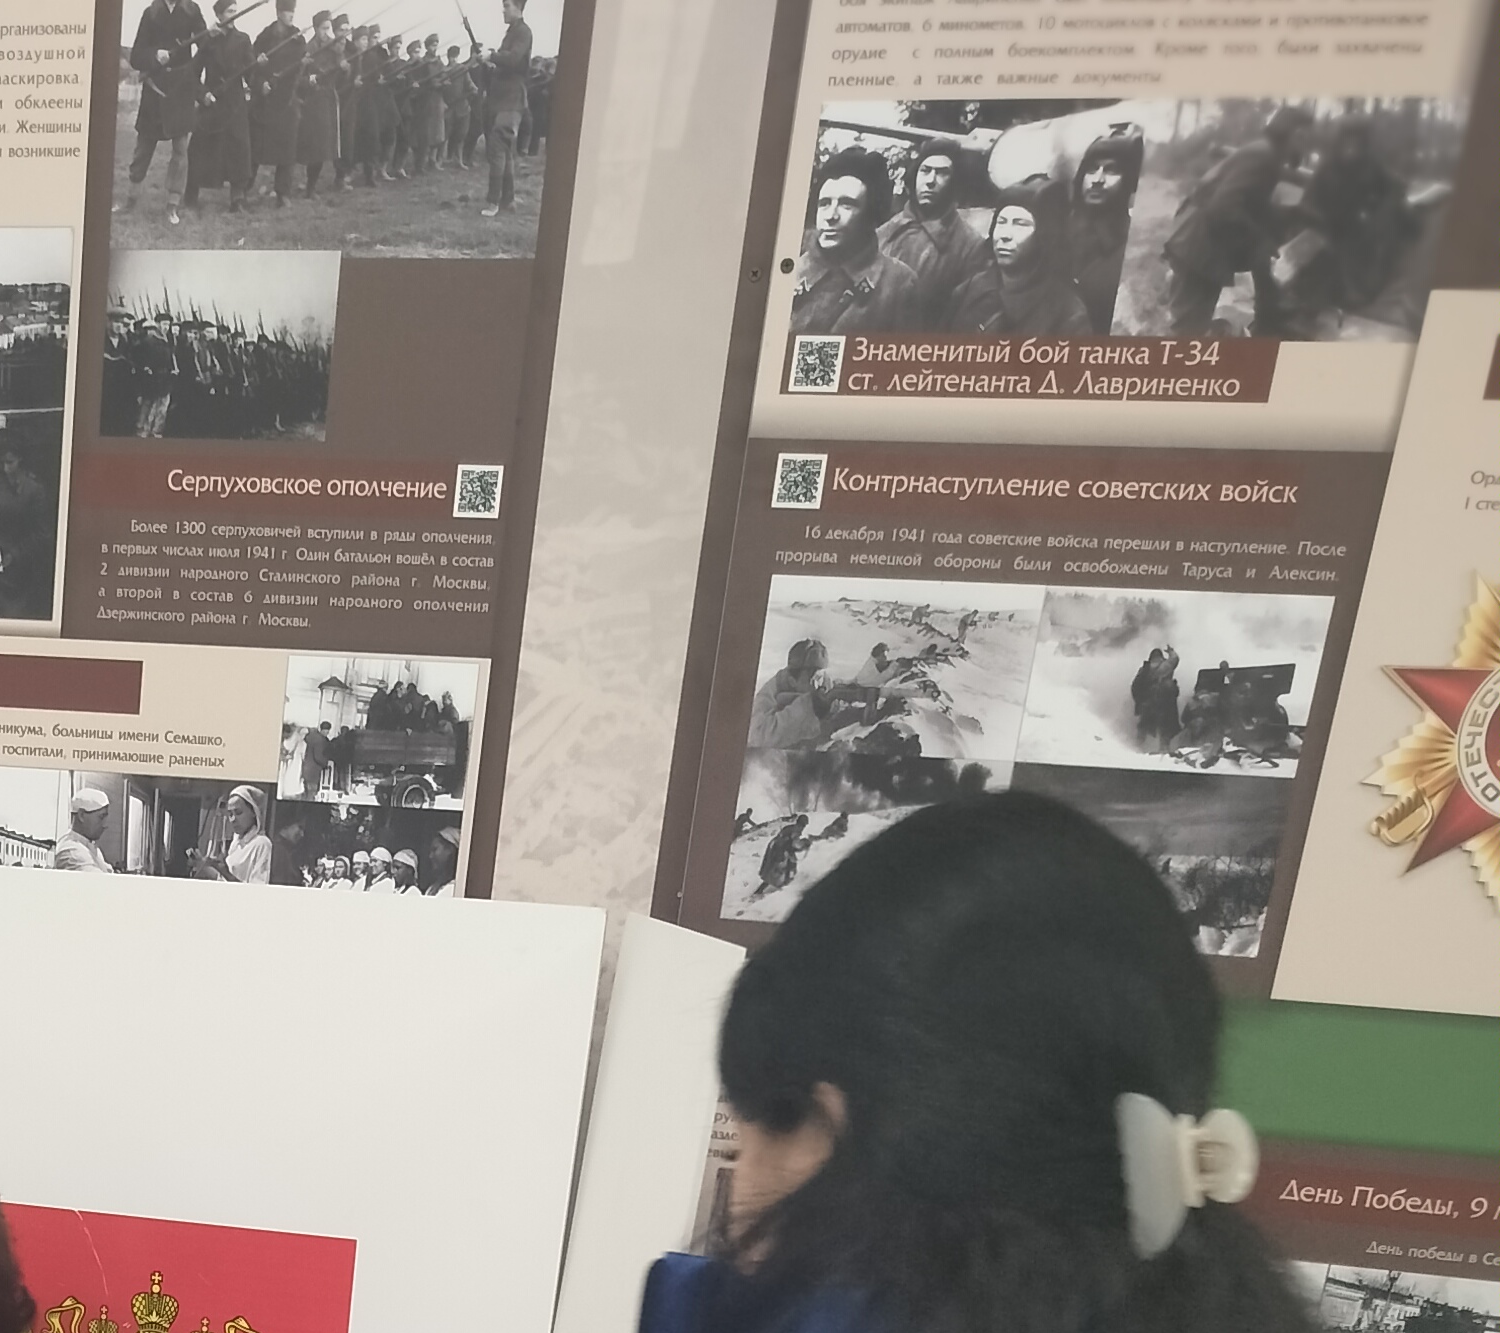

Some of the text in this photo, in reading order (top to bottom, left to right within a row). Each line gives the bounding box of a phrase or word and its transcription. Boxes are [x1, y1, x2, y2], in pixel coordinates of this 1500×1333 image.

[14, 94, 83, 110] обклеены
[16, 119, 82, 134] Женщины
[8, 147, 81, 158] возникшие
[853, 337, 1220, 366] Знаменитый бой танка Т-34
[848, 369, 1240, 399] ст. лейтенанта Д. Лавриненко
[168, 469, 447, 499] Серпуховское ополчение
[833, 468, 1298, 503] Контрнаступление советских войск
[131, 519, 416, 545] Более 1300 серпуховичей вступили ряды
[805, 525, 1347, 557] 16 декабря 1941 года советские войска перешли После
[112, 544, 494, 568] первых числах июля 1941 Один батальон вошёл состав
[775, 551, 1233, 581] прорыва немецкой обороны были освобождены Таруса
[118, 566, 400, 588] дивизии народного Сталинского района
[116, 587, 489, 613] второй состав дивизии народного ополчения
[97, 606, 236, 626] Дзержинского района
[52, 723, 114, 740] больницы
[118, 731, 160, 743] имени
[1464, 676, 1500, 802] ОТЕЧЕС
[72, 749, 164, 764] принимающие
[168, 755, 225, 768] раненых
[1280, 1179, 1343, 1205] День
[1352, 1186, 1458, 1218] Победы,
[1470, 1197, 1488, 1218] 9
[1365, 1241, 1403, 1256] День
[1408, 1246, 1464, 1262] победы
[1468, 1254, 1478, 1264] в
